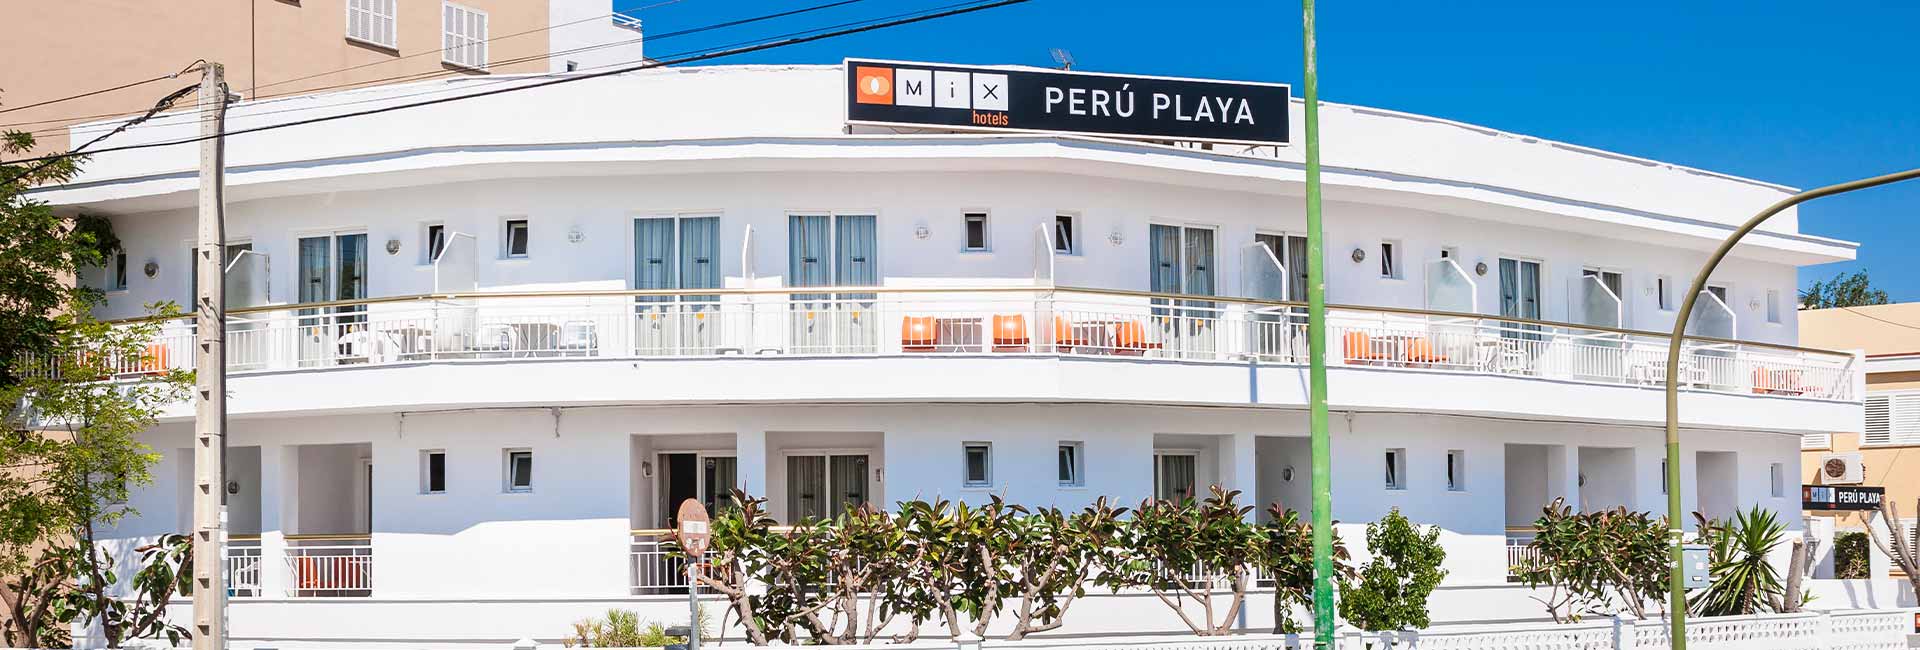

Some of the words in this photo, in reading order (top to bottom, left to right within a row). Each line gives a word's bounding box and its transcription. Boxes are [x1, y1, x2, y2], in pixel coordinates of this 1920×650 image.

[1045, 83, 1134, 118] PERÚ
[1152, 93, 1255, 125] PLAYA
[972, 109, 1009, 126] hotels
[1838, 489, 1858, 503] PERÚ
[1859, 491, 1881, 504] PLAYA
